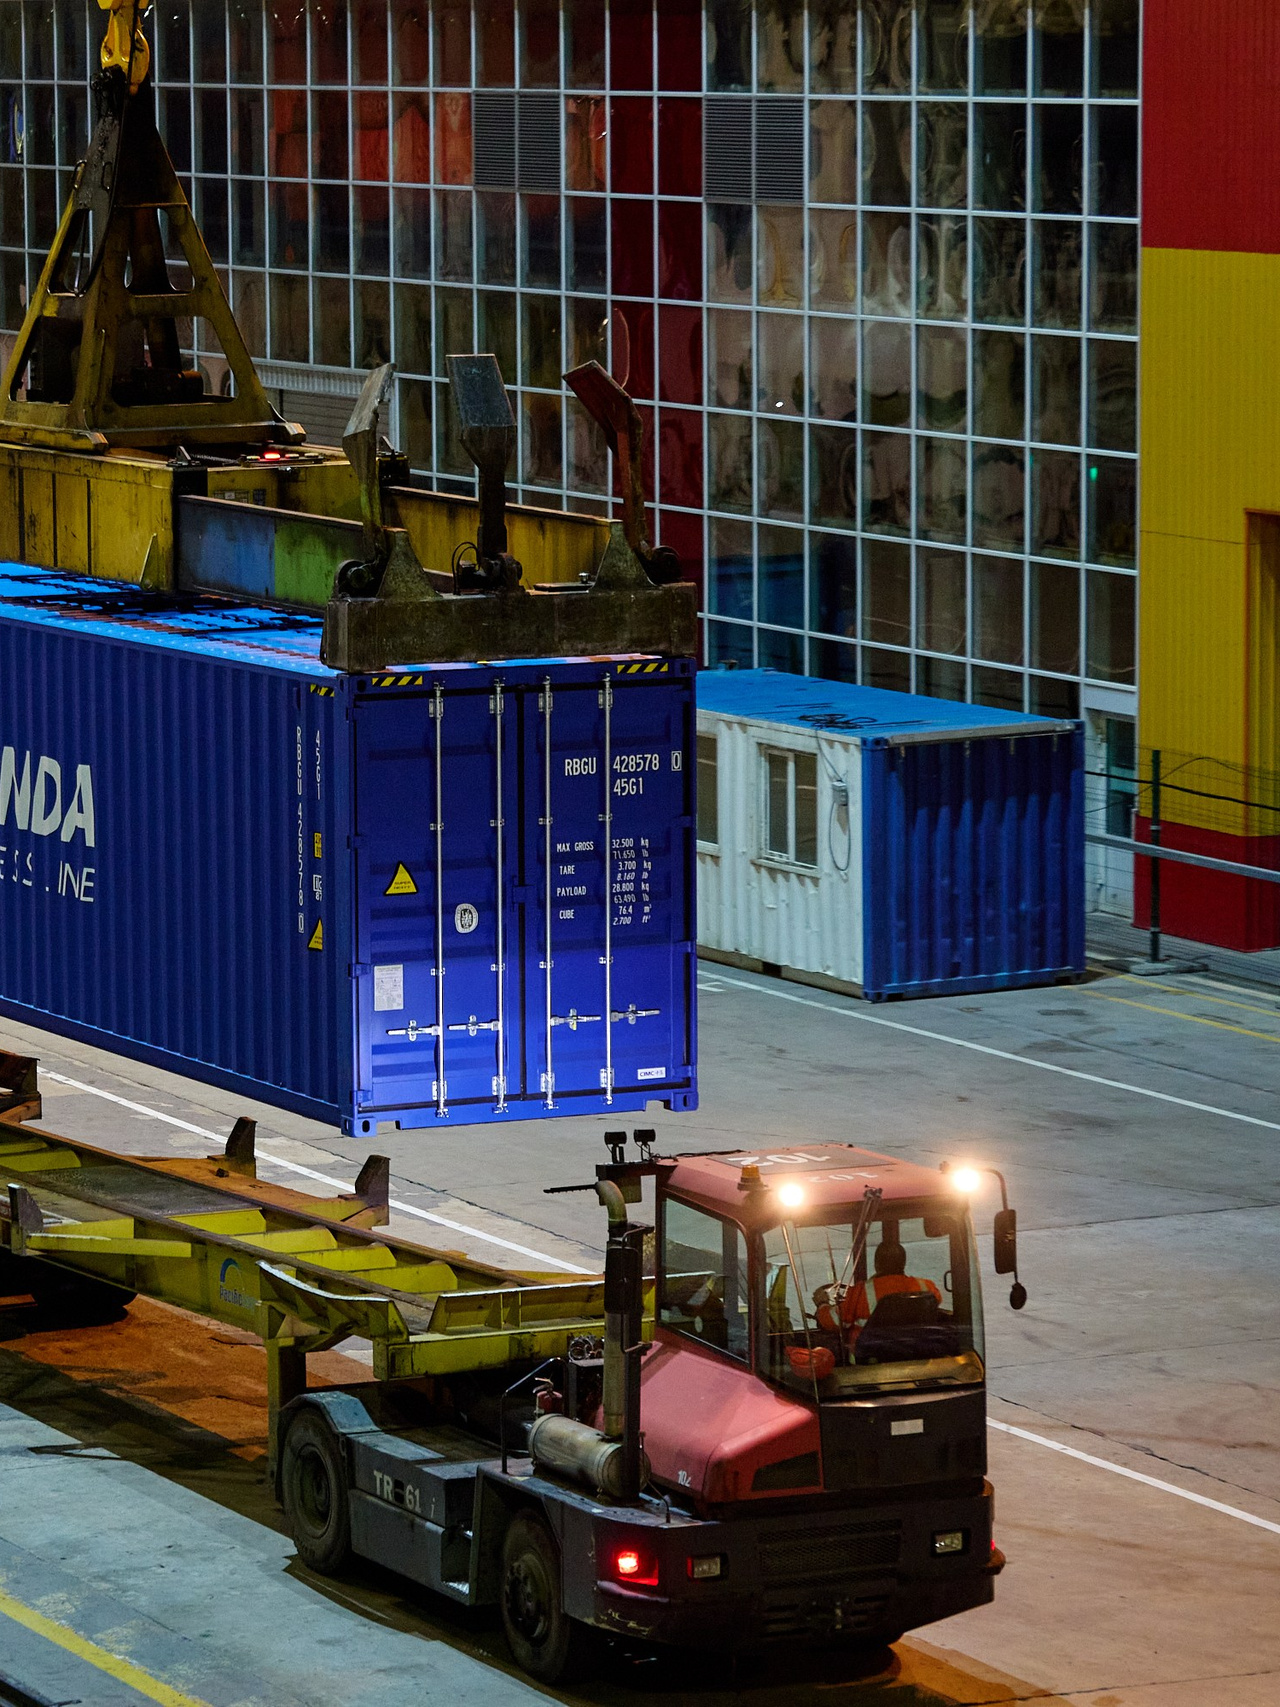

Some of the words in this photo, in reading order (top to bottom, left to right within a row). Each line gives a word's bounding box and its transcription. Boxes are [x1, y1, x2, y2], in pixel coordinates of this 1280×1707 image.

[564, 757, 597, 776] RBGU
[613, 754, 660, 773] 428578
[672, 752, 681, 770] 0
[613, 777, 643, 796] 45G1
[556, 843, 571, 852] MAX
[574, 841, 594, 851] GROSS
[612, 838, 634, 848] 32.500
[641, 837, 649, 848] kg
[559, 865, 575, 875] TARE
[618, 861, 637, 870] 3.700
[643, 860, 652, 871] kg
[556, 886, 587, 897] PAYLOAD
[612, 882, 634, 893] 28.800
[641, 881, 650, 892] kg
[559, 909, 575, 919] CUBE
[618, 905, 633, 915] 76.4
